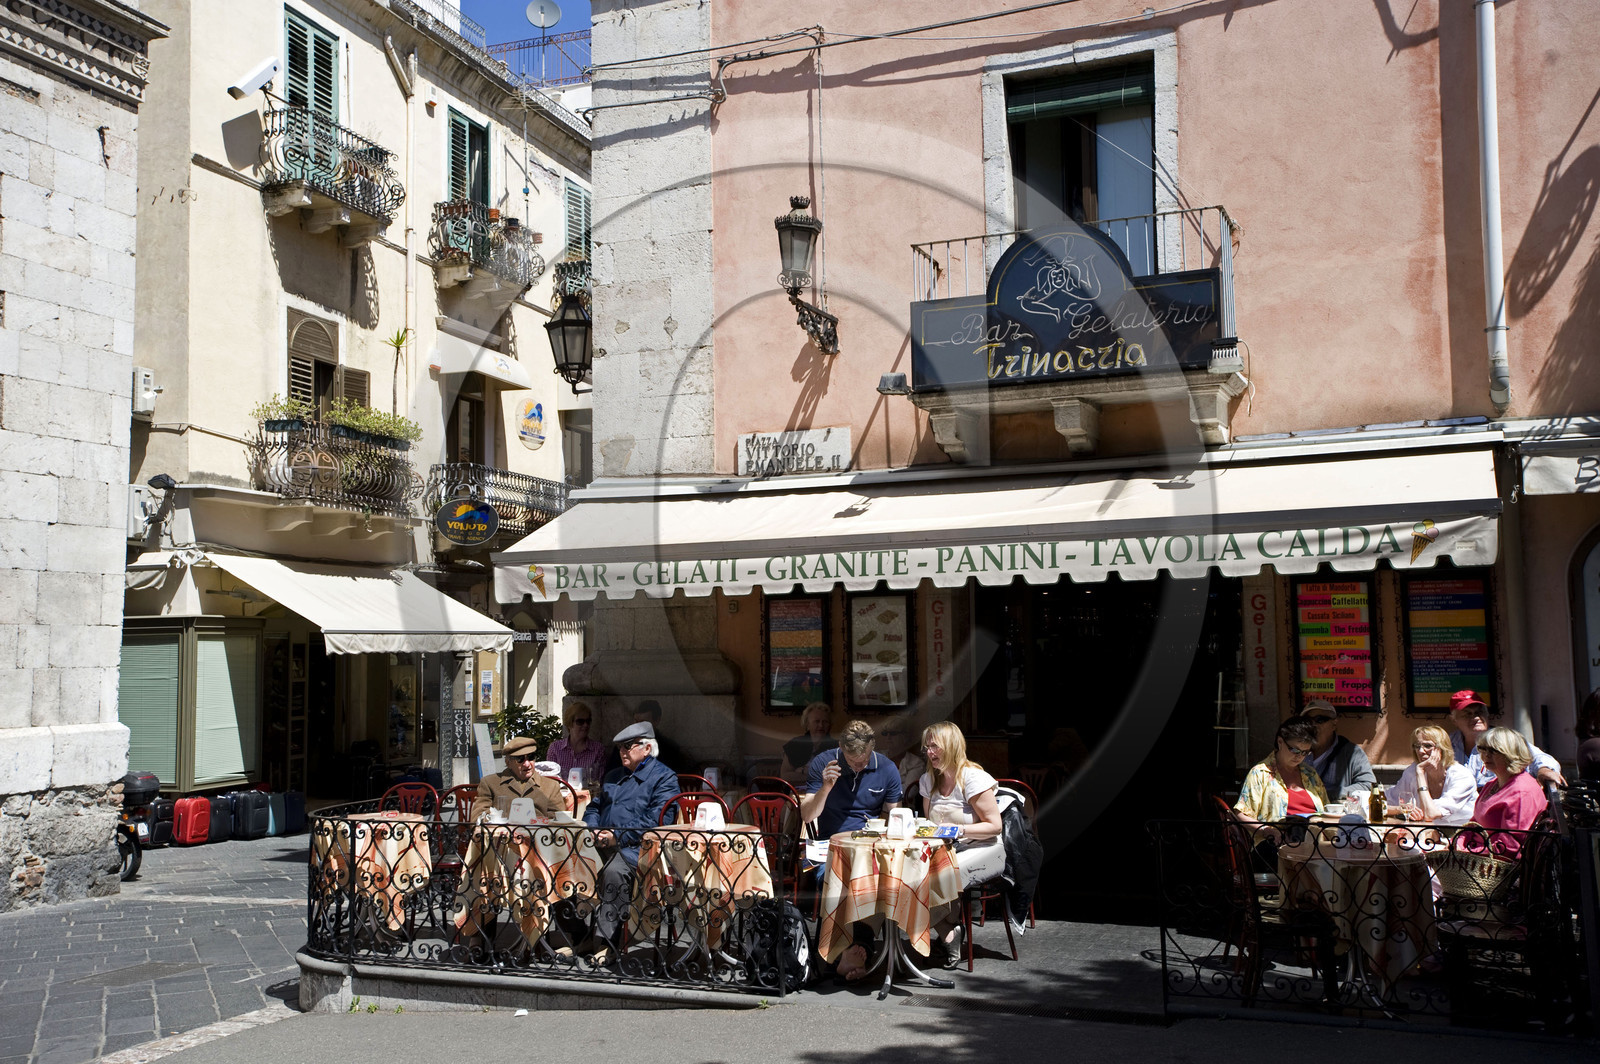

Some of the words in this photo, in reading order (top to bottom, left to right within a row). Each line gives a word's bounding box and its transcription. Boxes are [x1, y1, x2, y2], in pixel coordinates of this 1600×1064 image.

[951, 313, 1033, 345] Bar
[1064, 297, 1213, 340] Gelateria
[973, 337, 1148, 378] Trinacria
[745, 436, 779, 448] PIAZZA
[746, 443, 815, 459] VITTORIO
[746, 455, 824, 473] EMANUELE
[554, 564, 609, 589] BAR
[632, 558, 739, 587] GELATI
[764, 549, 909, 581] GRANITE
[935, 541, 1060, 574] PANINI
[1085, 532, 1246, 567] TAVOLA
[1257, 524, 1404, 559] CALDA
[931, 599, 945, 697] Granite
[1251, 593, 1267, 696] Gelati
[1300, 680, 1334, 689] Spremute
[1332, 666, 1354, 675] Freddo
[1348, 695, 1371, 704] CON
[454, 712, 464, 758] CORVAIA
